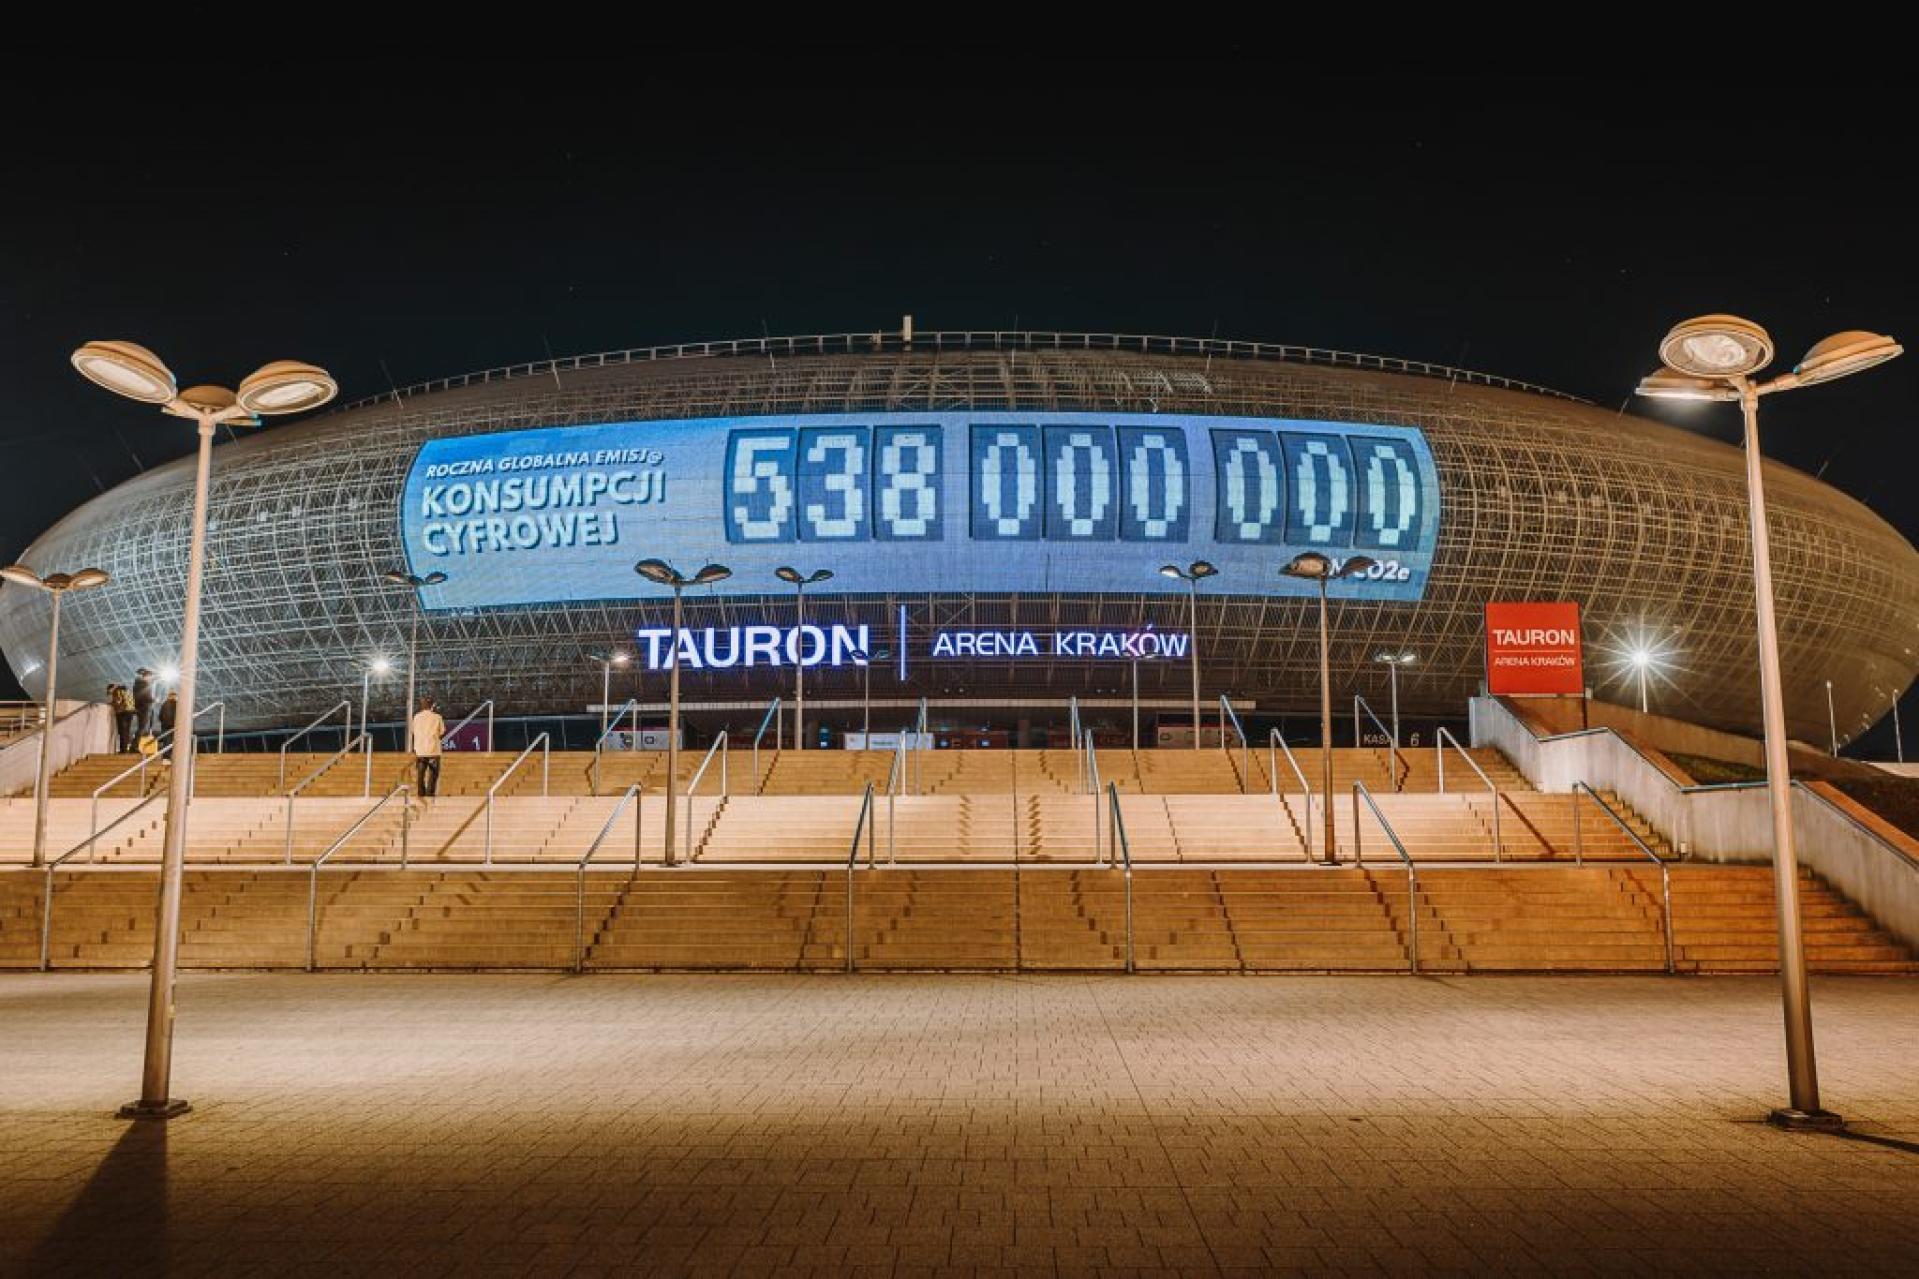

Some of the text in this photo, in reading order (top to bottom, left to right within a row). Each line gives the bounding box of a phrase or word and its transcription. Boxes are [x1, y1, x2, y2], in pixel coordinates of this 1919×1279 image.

[426, 458, 493, 479] ROCZNA
[499, 451, 590, 473] GLOBALNA
[422, 470, 666, 518] KONSUMPCJI
[734, 433, 1416, 545] 538 000 000
[422, 511, 619, 556] CYFROWEJ
[638, 623, 1188, 670] TAURON ARENA KRAKÓW
[1492, 629, 1575, 646] TAURON
[1494, 654, 1576, 667] ARENA KRAKÓW
